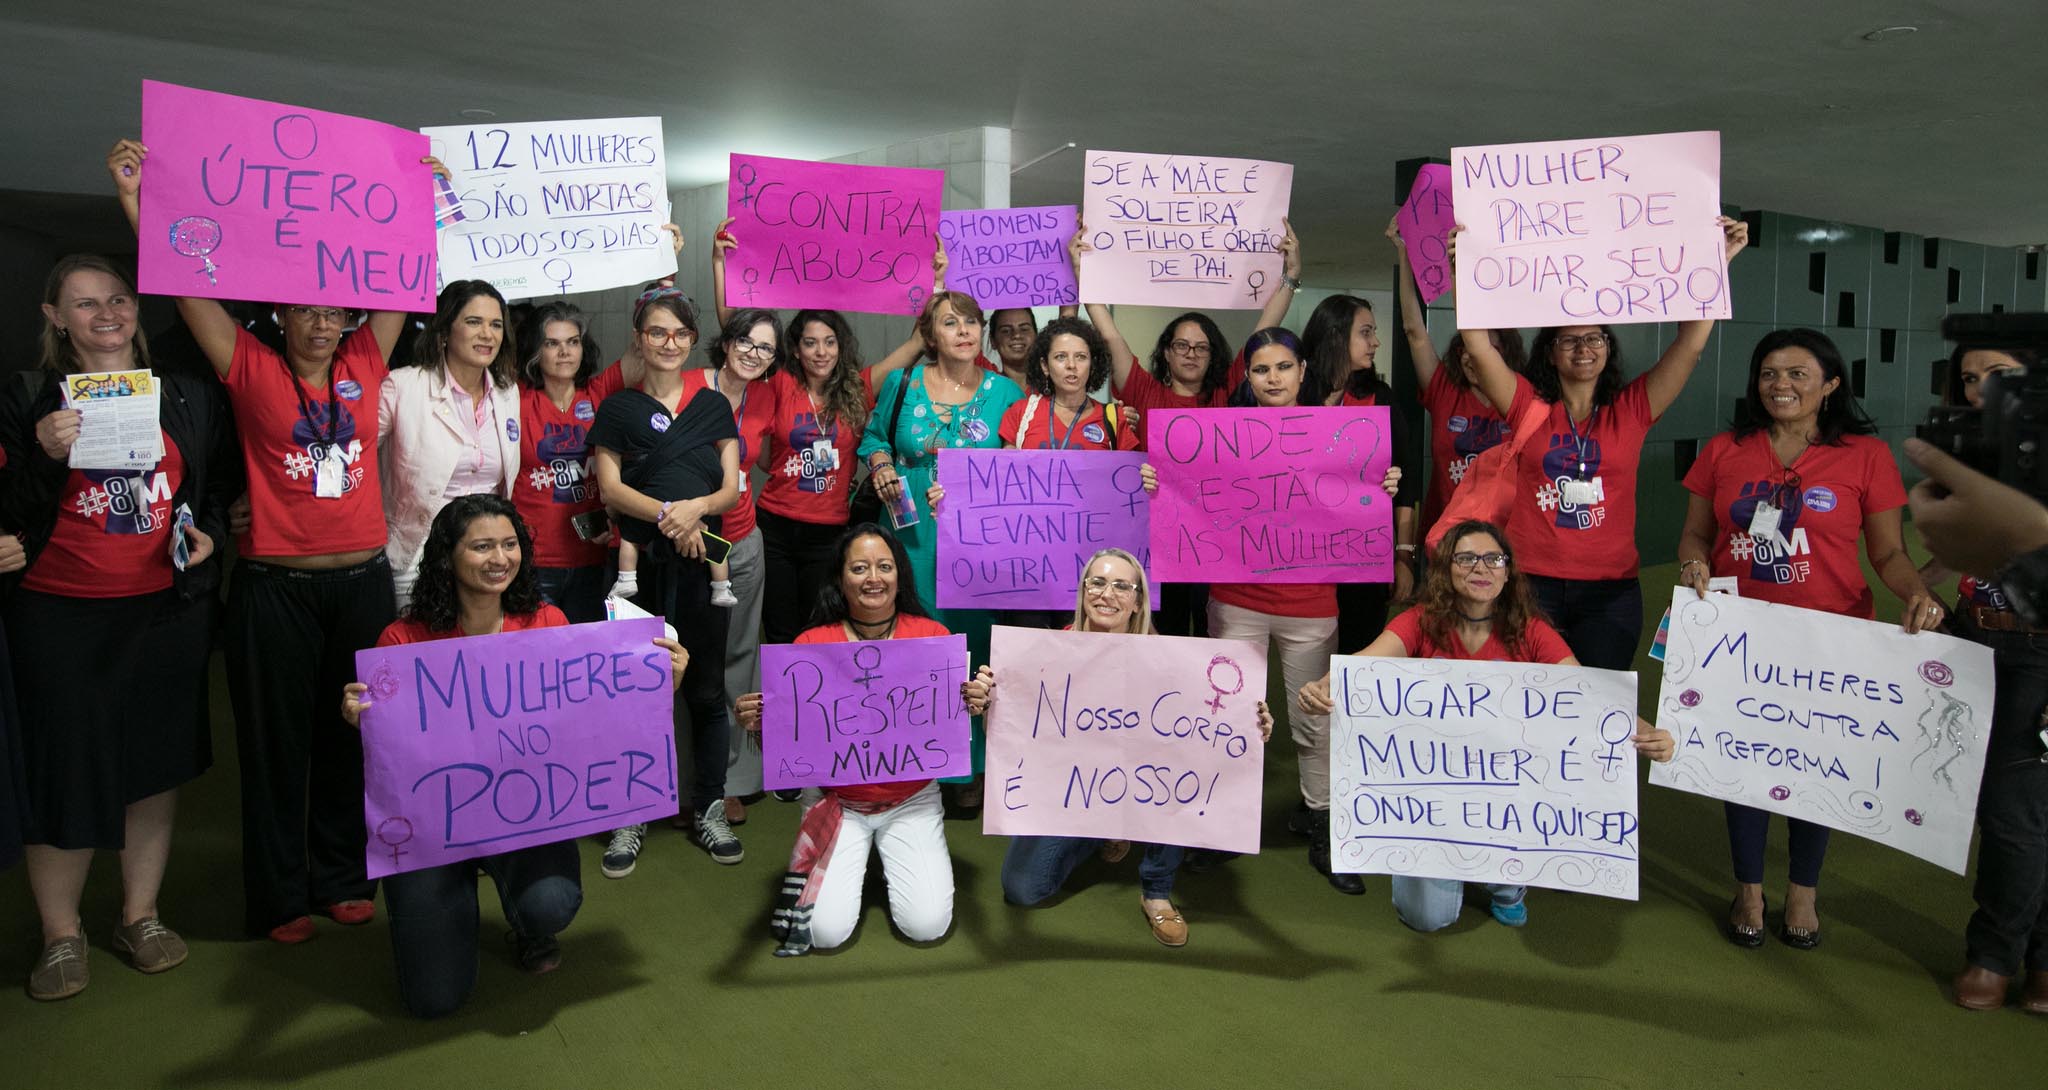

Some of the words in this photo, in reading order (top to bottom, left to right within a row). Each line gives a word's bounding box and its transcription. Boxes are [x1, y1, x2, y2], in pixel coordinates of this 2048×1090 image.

[273, 114, 318, 161] O
[466, 129, 517, 171] 12
[531, 133, 656, 170] MULHERES
[201, 144, 398, 224] ÚTERO
[1091, 157, 1133, 187] SE
[1141, 165, 1160, 190] A
[1243, 165, 1260, 194] É
[1464, 143, 1630, 190] MULHER,
[460, 182, 528, 222] SÃO
[542, 181, 653, 215] MORTAS
[753, 182, 928, 239] CONTRA
[960, 210, 1059, 238] HOMENS
[1490, 198, 1589, 244] PARE
[1608, 191, 1677, 233] DE
[275, 210, 303, 249] É
[455, 231, 557, 263] TODOS
[562, 228, 595, 250] OS
[598, 222, 660, 249] DIAS
[1094, 231, 1115, 251] O
[1124, 225, 1195, 251] FILHO
[1202, 225, 1216, 250] É
[1223, 225, 1285, 253] ÓRFÃO
[316, 239, 432, 303] MEU!
[768, 241, 921, 286] ABUSO
[960, 238, 1066, 270] ABORTAM
[1150, 258, 1181, 279] DE
[1474, 254, 1589, 294] ODIAR
[1608, 244, 1685, 285] SEU
[955, 272, 1029, 300] TODOS
[1033, 271, 1059, 292] OS
[1030, 283, 1078, 307] DIAS
[1164, 413, 1315, 465] ONDE
[76, 471, 173, 519] #8M
[813, 475, 837, 494] DF
[967, 453, 1084, 503] MANA
[1200, 466, 1351, 513] ESTÃO
[134, 506, 168, 535] DF
[957, 510, 1110, 545] LEVANTE
[1576, 507, 1606, 530] DF
[1177, 528, 1224, 567] AS
[1240, 525, 1392, 566] MULHERES
[951, 553, 1058, 588] OUTRA
[1773, 561, 1811, 585] DF
[414, 649, 667, 732] MULHERES
[1702, 631, 1905, 705] MULHERES
[1342, 666, 1498, 720] LUGAR
[1522, 687, 1584, 719] DE
[1736, 697, 1900, 742] CONTRA
[497, 723, 551, 763] NO
[778, 756, 814, 780] AS
[830, 739, 950, 780] MINAS
[1358, 734, 1541, 784] MULHER
[1560, 736, 1584, 782] É
[1685, 726, 1705, 749] A
[1715, 730, 1850, 782] REFORMA
[412, 733, 677, 843] PODER!
[1002, 757, 1028, 811] É
[1063, 763, 1220, 817] NOSSO!
[1353, 793, 1447, 827] ONDE
[1463, 801, 1522, 833] ELA
[1532, 801, 1638, 853] QUISER
